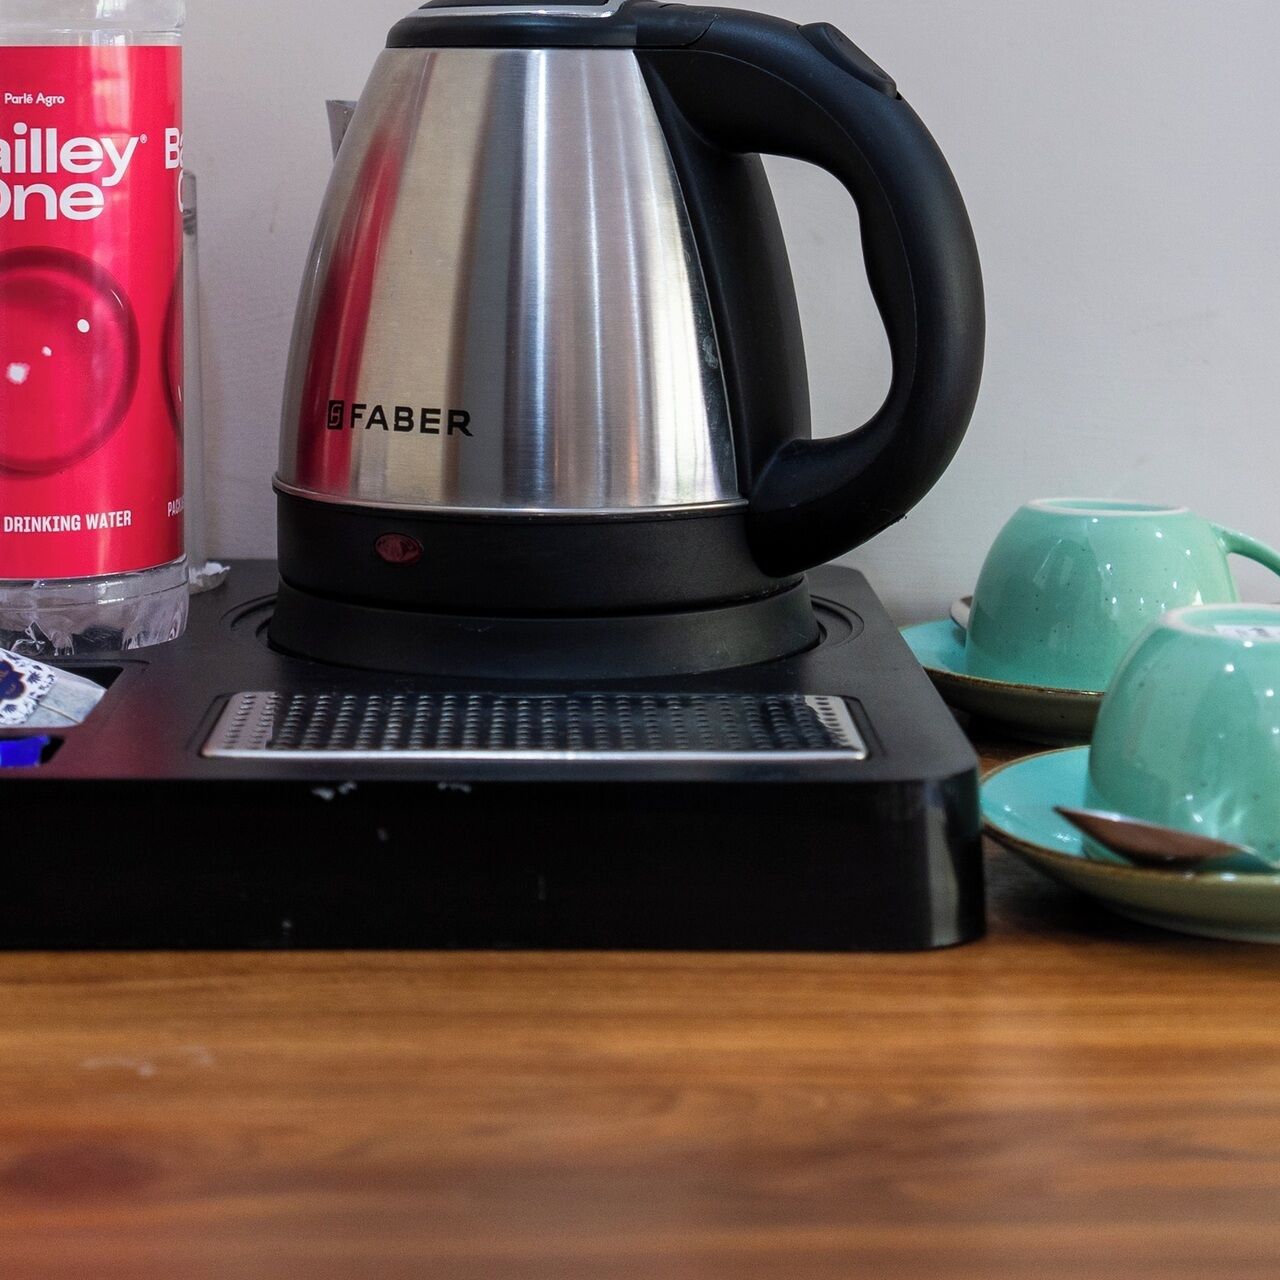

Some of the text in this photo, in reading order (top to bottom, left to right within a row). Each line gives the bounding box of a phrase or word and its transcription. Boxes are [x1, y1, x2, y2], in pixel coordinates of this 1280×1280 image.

[35, 92, 65, 107] Agro
[165, 127, 183, 169] B
[350, 403, 474, 437] FABER
[4, 514, 81, 533] DRINKING
[85, 510, 132, 529] WATER
